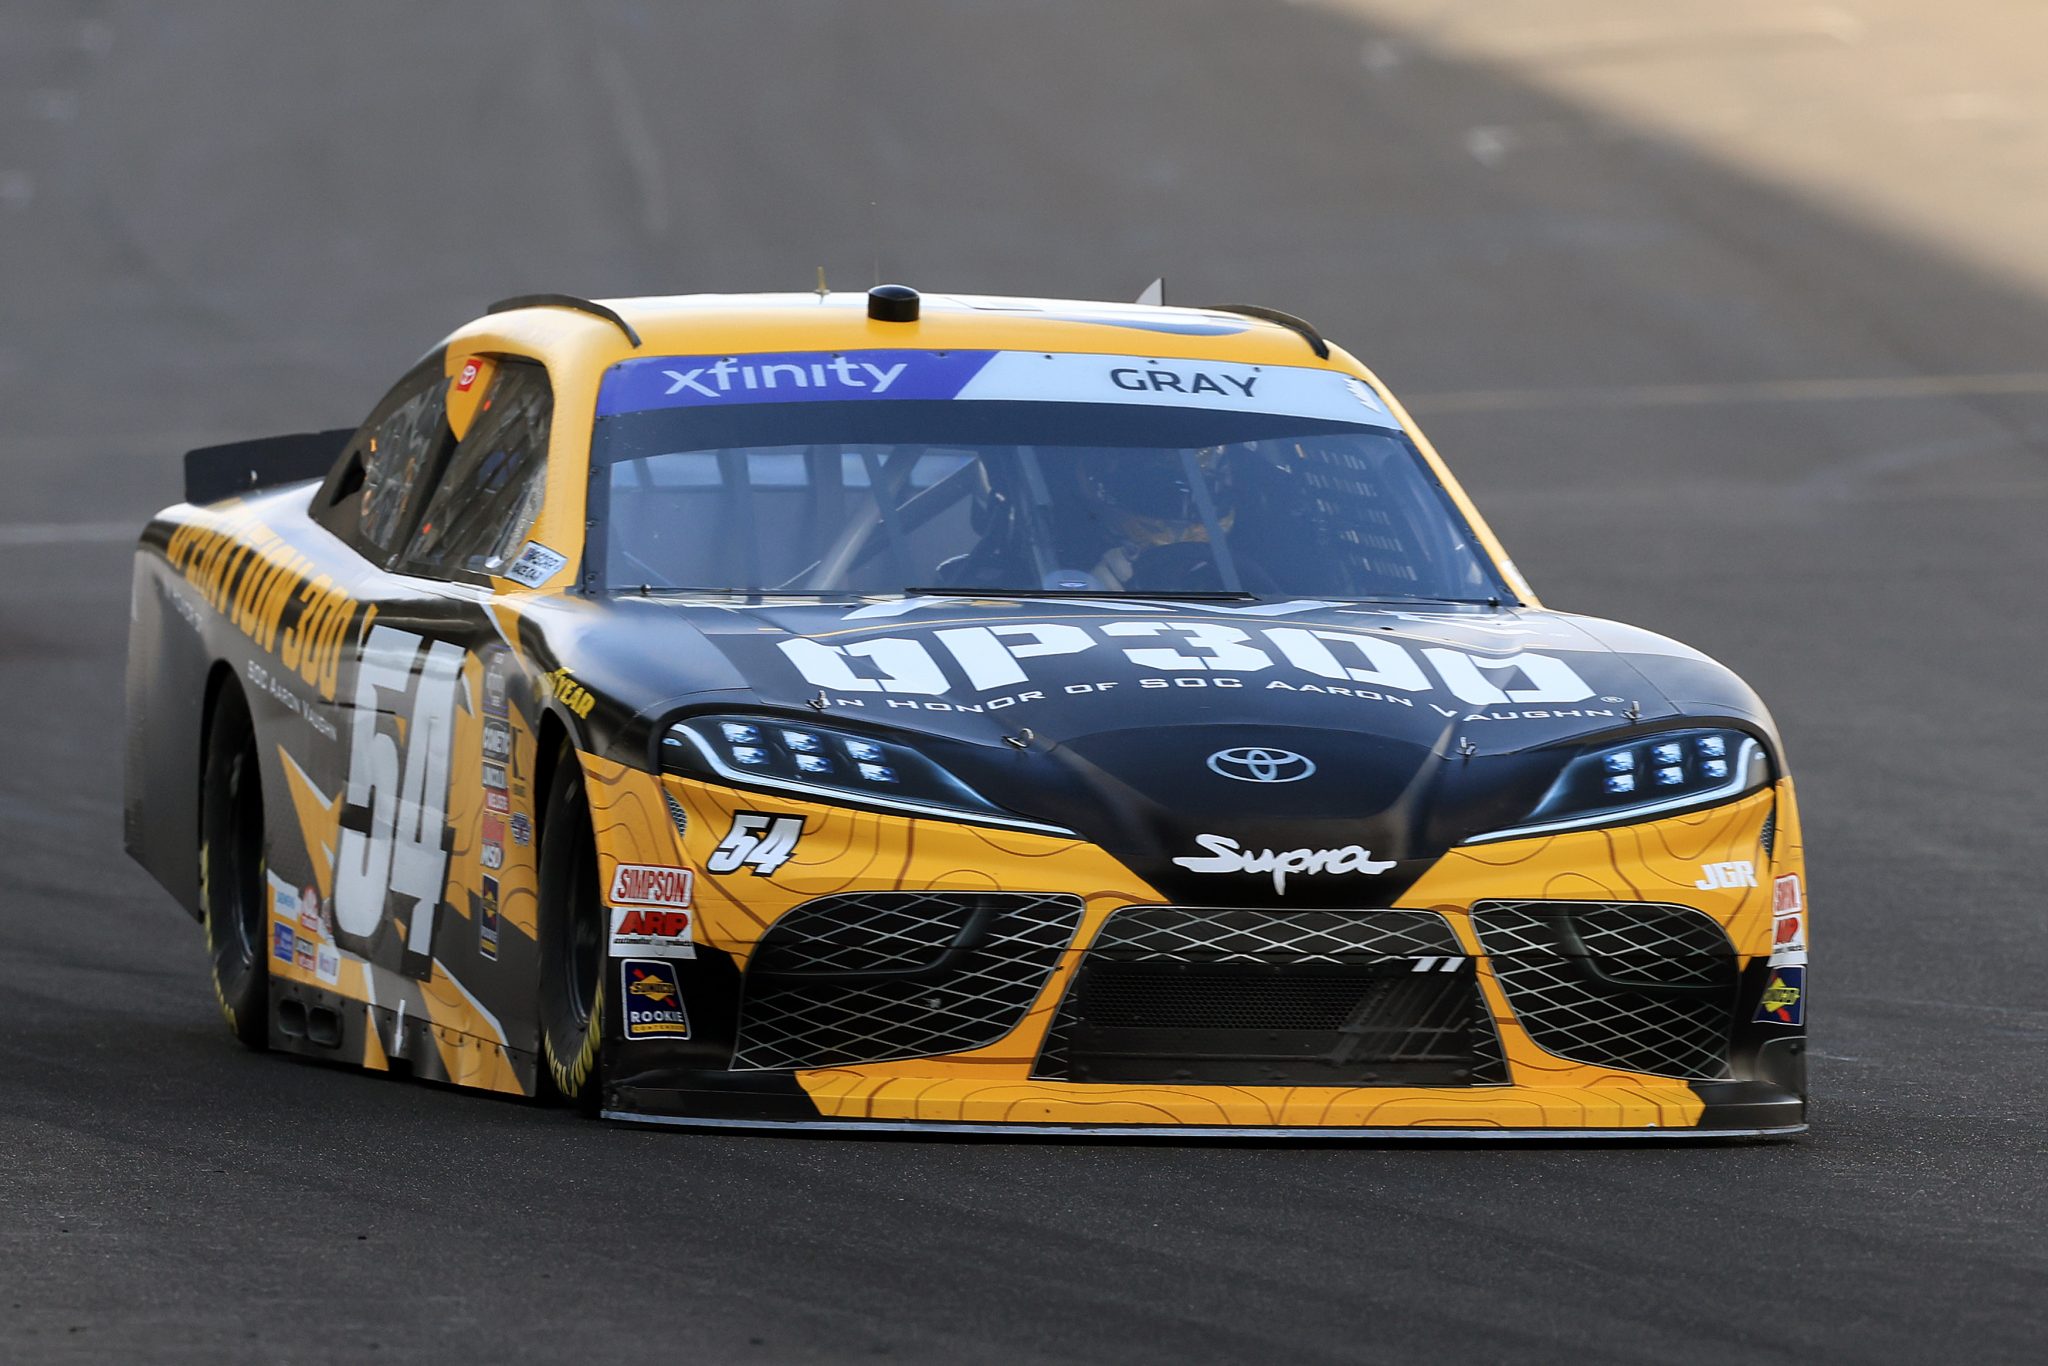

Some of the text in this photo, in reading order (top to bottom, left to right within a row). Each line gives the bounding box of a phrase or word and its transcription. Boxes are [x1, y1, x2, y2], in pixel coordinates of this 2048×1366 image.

[661, 357, 908, 398] xfinity
[1110, 368, 1257, 397] GRAY
[281, 573, 359, 702] 300
[886, 690, 1046, 713] HONOR
[1064, 682, 1119, 694] OF
[1139, 677, 1244, 689] SOC
[1265, 680, 1414, 707] AARON
[1429, 703, 1615, 722] VAUGHN
[334, 625, 466, 956] 54
[706, 811, 806, 876] 54
[1172, 833, 1398, 896] Supra
[1695, 861, 1758, 890] JGR
[617, 868, 688, 903] SIMPSON
[616, 910, 689, 937] ARP
[630, 1010, 685, 1023] ROOKIE
